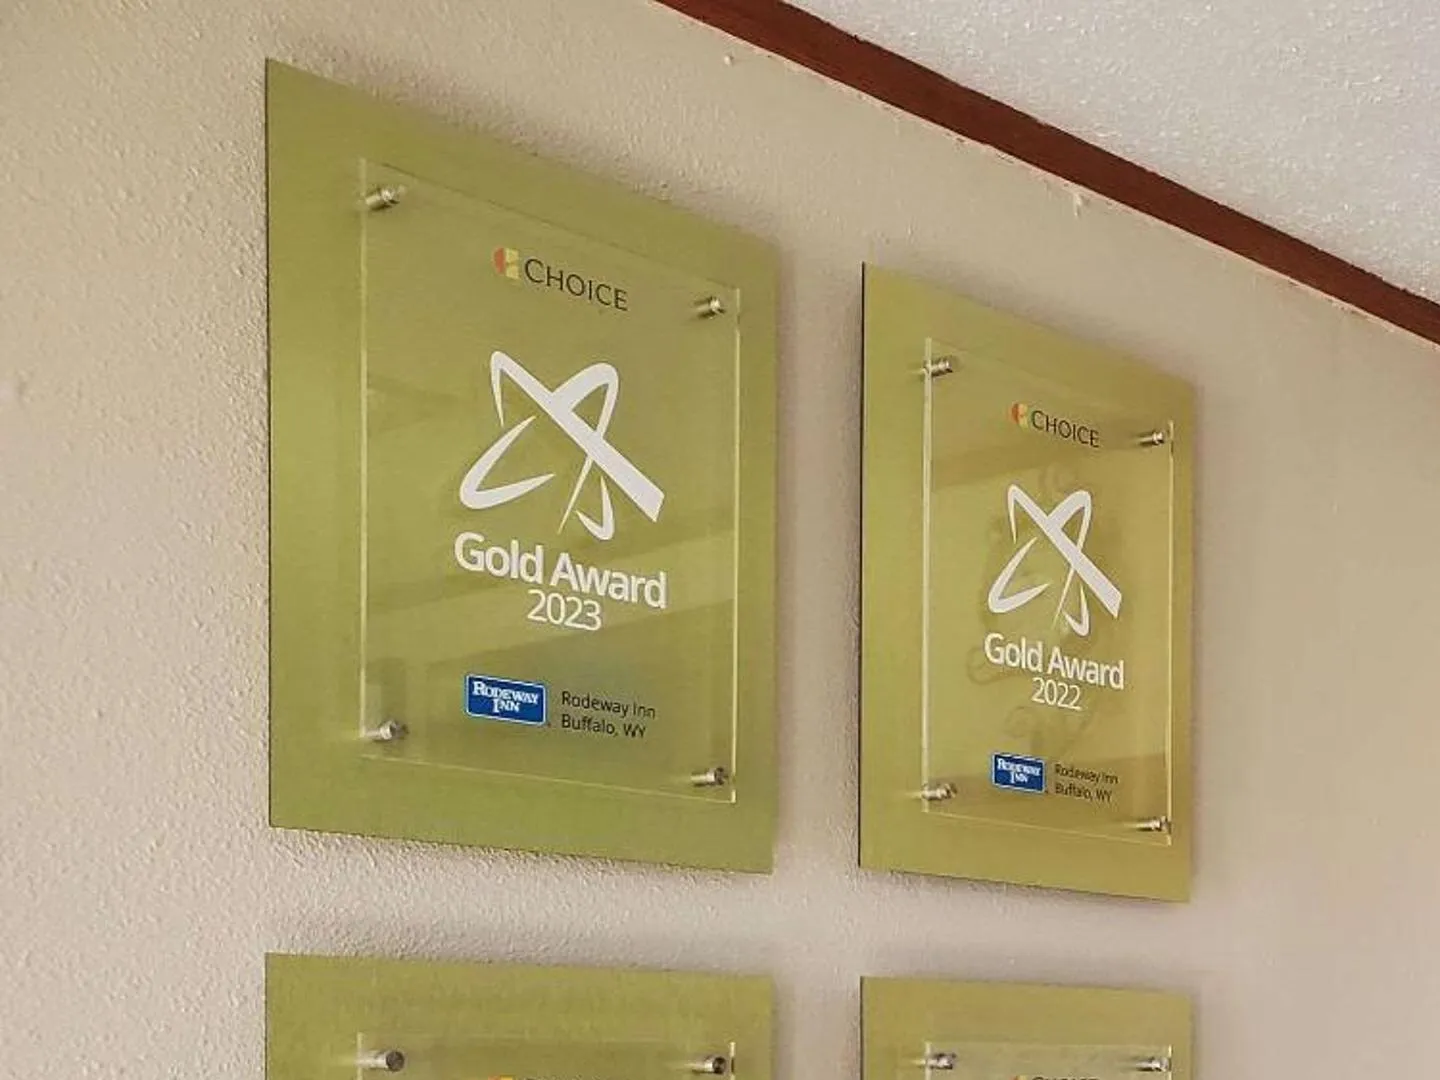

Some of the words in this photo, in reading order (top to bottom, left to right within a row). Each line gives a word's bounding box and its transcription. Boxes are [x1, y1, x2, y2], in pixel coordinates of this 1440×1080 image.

[524, 259, 628, 311] CHOICE
[1032, 410, 1100, 448] CHOICE
[454, 532, 543, 584] Gold
[550, 551, 668, 608] Award
[527, 590, 601, 631] 2023
[984, 632, 1043, 673] Gold
[1047, 647, 1124, 690] Award
[562, 691, 630, 717] Rodeway
[633, 701, 656, 720] Inn
[1032, 677, 1083, 711] 2022
[562, 714, 618, 736] Buffalo,
[623, 722, 646, 738] WY
[1054, 763, 1101, 783] Rodeway
[1055, 783, 1093, 802] Buffalo,
[1095, 789, 1113, 803] WY
